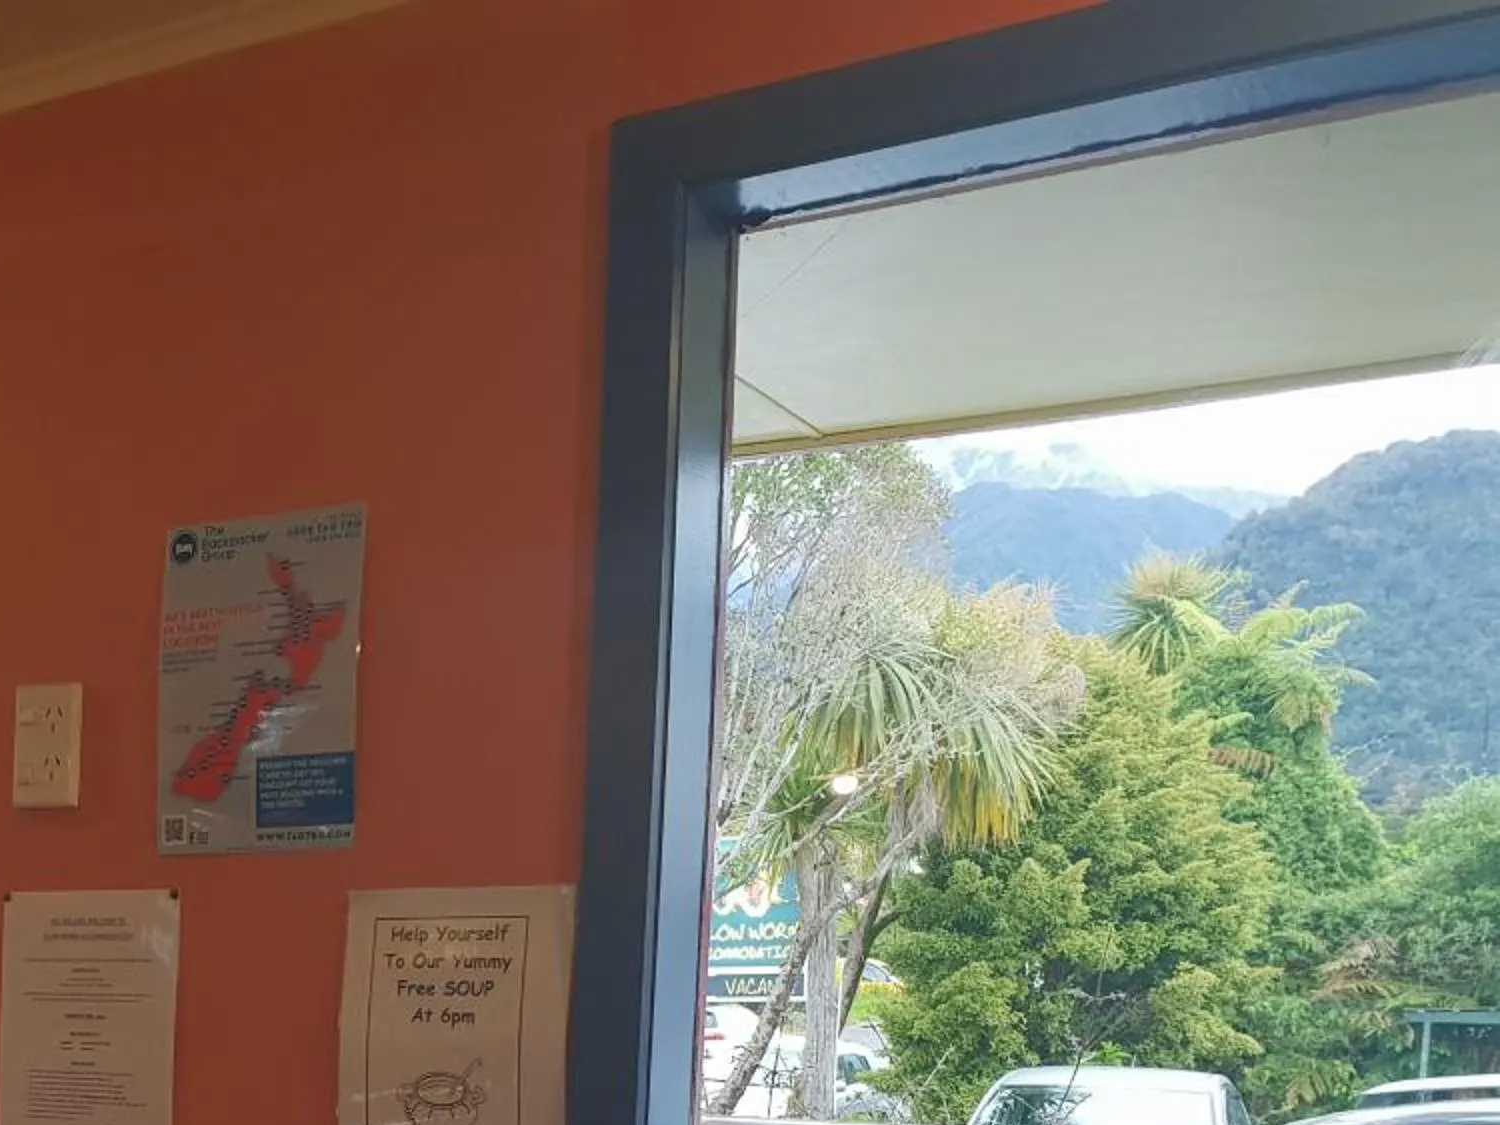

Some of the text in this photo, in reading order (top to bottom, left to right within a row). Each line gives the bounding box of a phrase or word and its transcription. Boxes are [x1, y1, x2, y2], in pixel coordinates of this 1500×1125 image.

[203, 526, 225, 537] The
[391, 923, 510, 947] Help Yourself
[384, 951, 514, 975] To Our Yummy
[397, 979, 495, 998] Free SOUP
[411, 1007, 476, 1030] At 6pm
